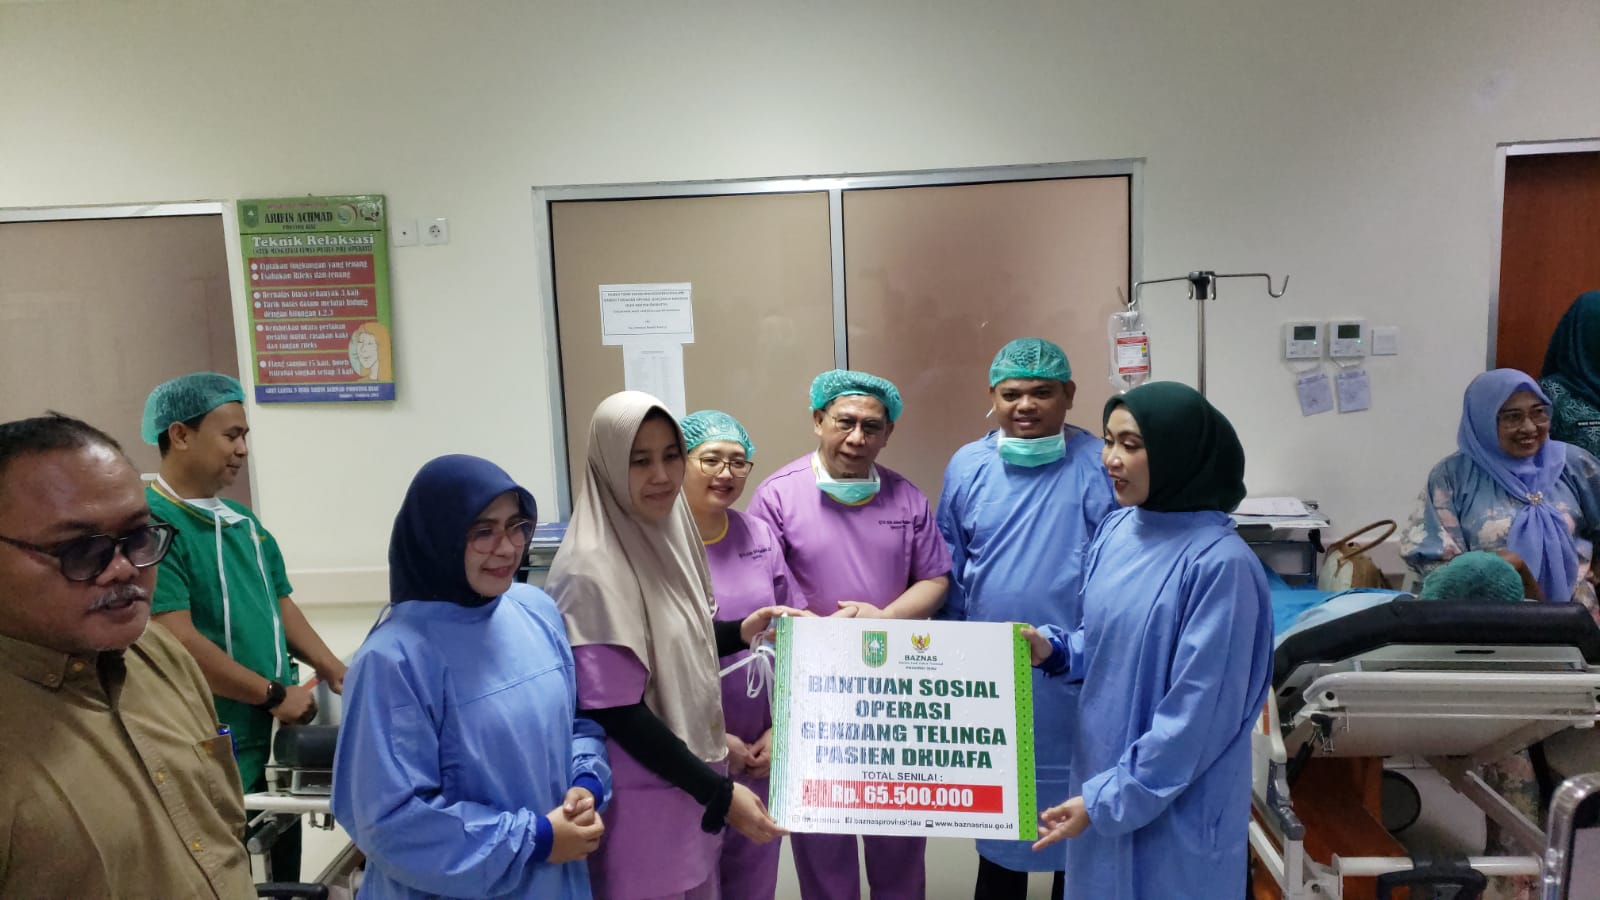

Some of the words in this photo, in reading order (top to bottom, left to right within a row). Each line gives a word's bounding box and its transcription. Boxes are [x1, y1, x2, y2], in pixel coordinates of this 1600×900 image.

[264, 212, 294, 224] ARIFIN
[296, 211, 333, 223] ACHMAD
[252, 236, 302, 248] Teknik
[307, 233, 375, 245] Relaksasi
[808, 675, 913, 696] BANTUAN
[918, 678, 1000, 699] SOSIAL
[855, 700, 951, 720] OPERASI
[801, 721, 908, 742] GENDANG
[913, 725, 1007, 745] TELINGA
[815, 745, 895, 766] PASIEN
[902, 748, 992, 769] DHUAFA
[862, 770, 895, 781] TOTAL
[897, 772, 938, 782] SENILAI
[831, 785, 860, 805] Rp.
[864, 786, 974, 807] 65.500.000
